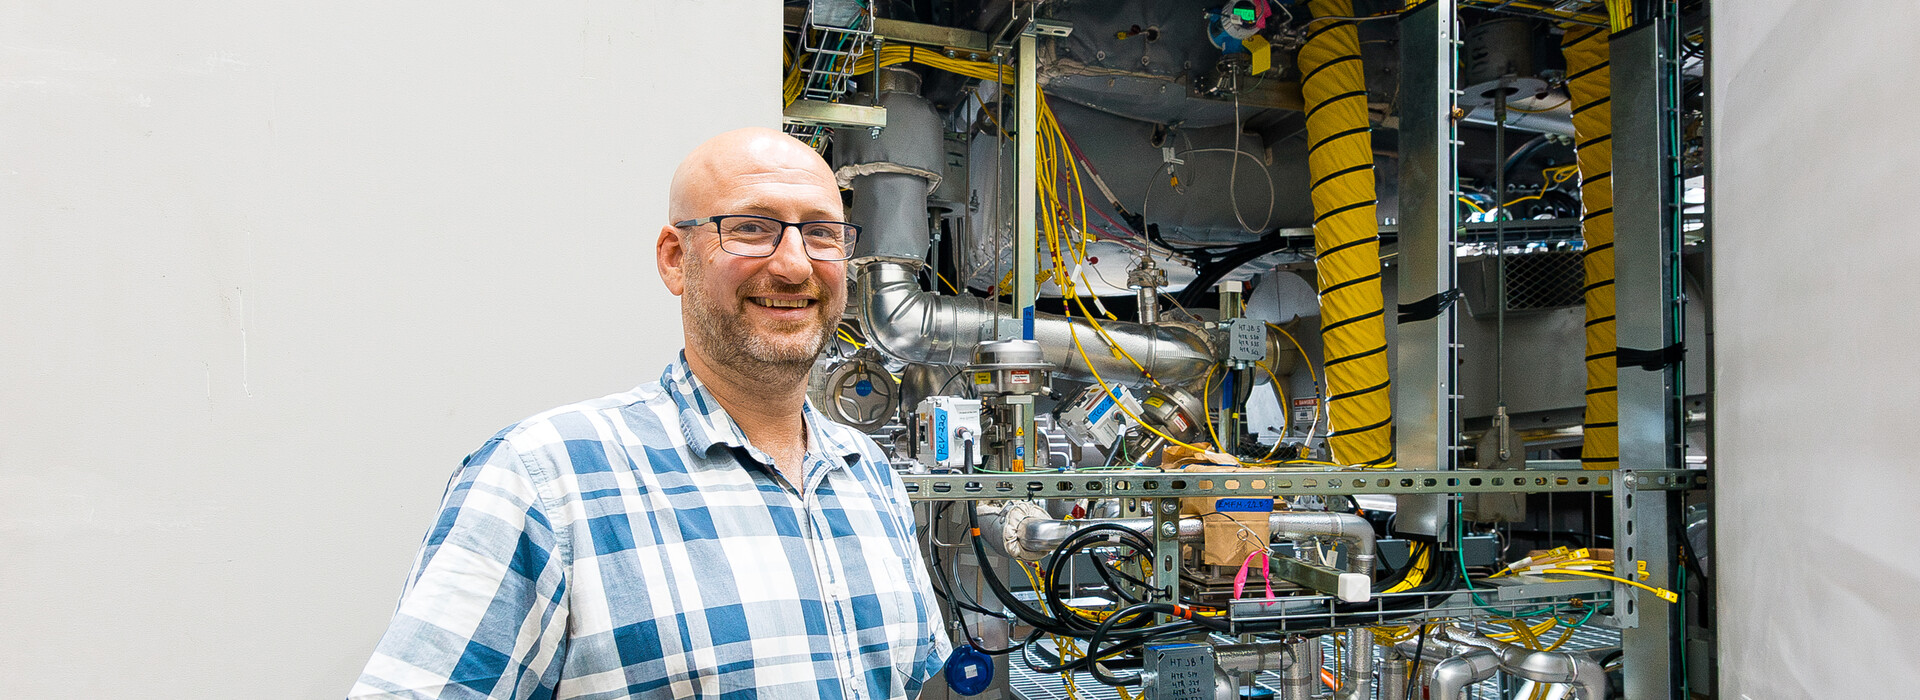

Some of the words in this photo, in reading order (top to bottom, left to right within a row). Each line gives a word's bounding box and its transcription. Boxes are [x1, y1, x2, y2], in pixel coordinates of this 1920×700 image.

[1092, 391, 1119, 418] TCV-20
[937, 414, 948, 456] PCV-220
[1170, 658, 1182, 667] HT
[1185, 657, 1197, 667] JB
[1171, 672, 1185, 680] HTR
[1172, 680, 1186, 688] HTR
